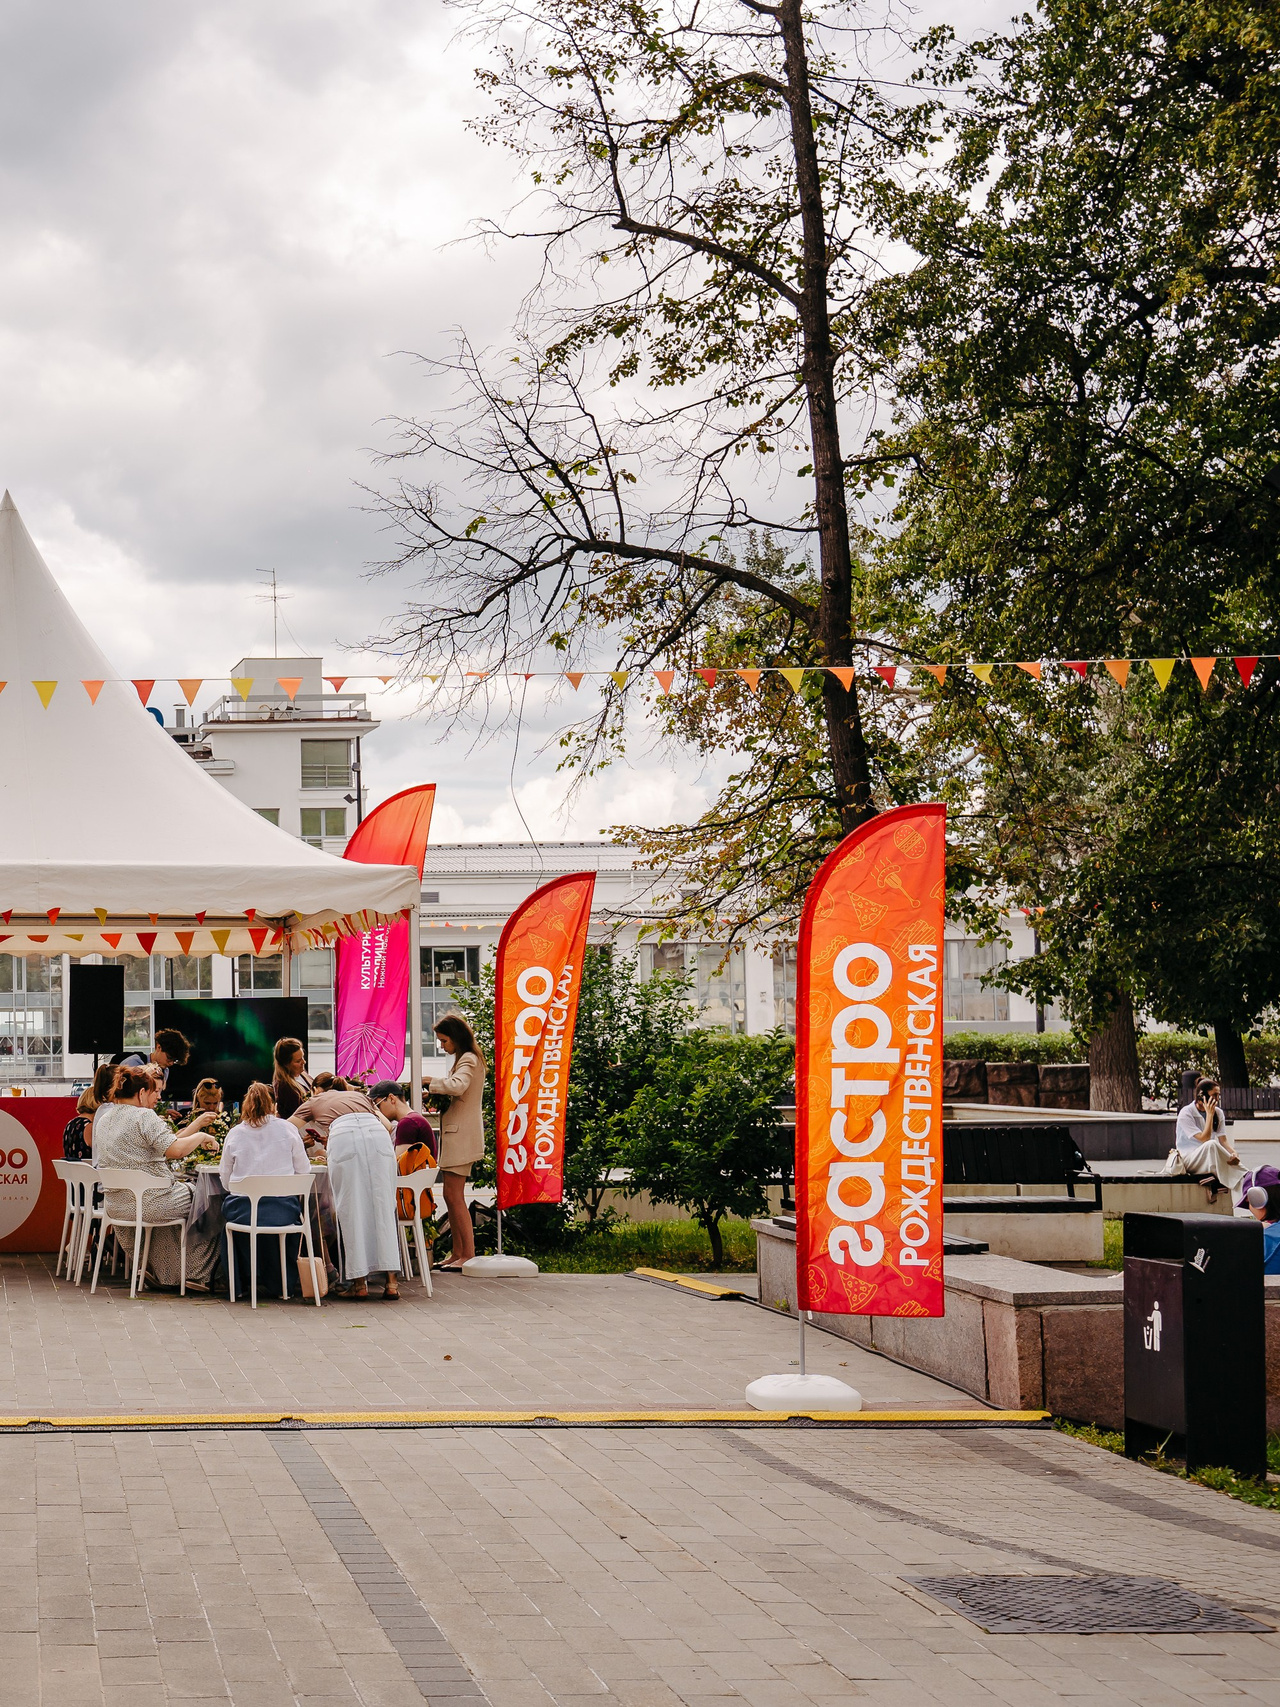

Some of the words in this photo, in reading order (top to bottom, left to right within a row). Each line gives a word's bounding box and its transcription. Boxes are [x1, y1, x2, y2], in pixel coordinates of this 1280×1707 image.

[360, 930, 371, 990] КУЛЬТУРН
[825, 942, 900, 1266] гастро
[899, 944, 937, 1266] РОЖДЕСТВЕНСКАЯ
